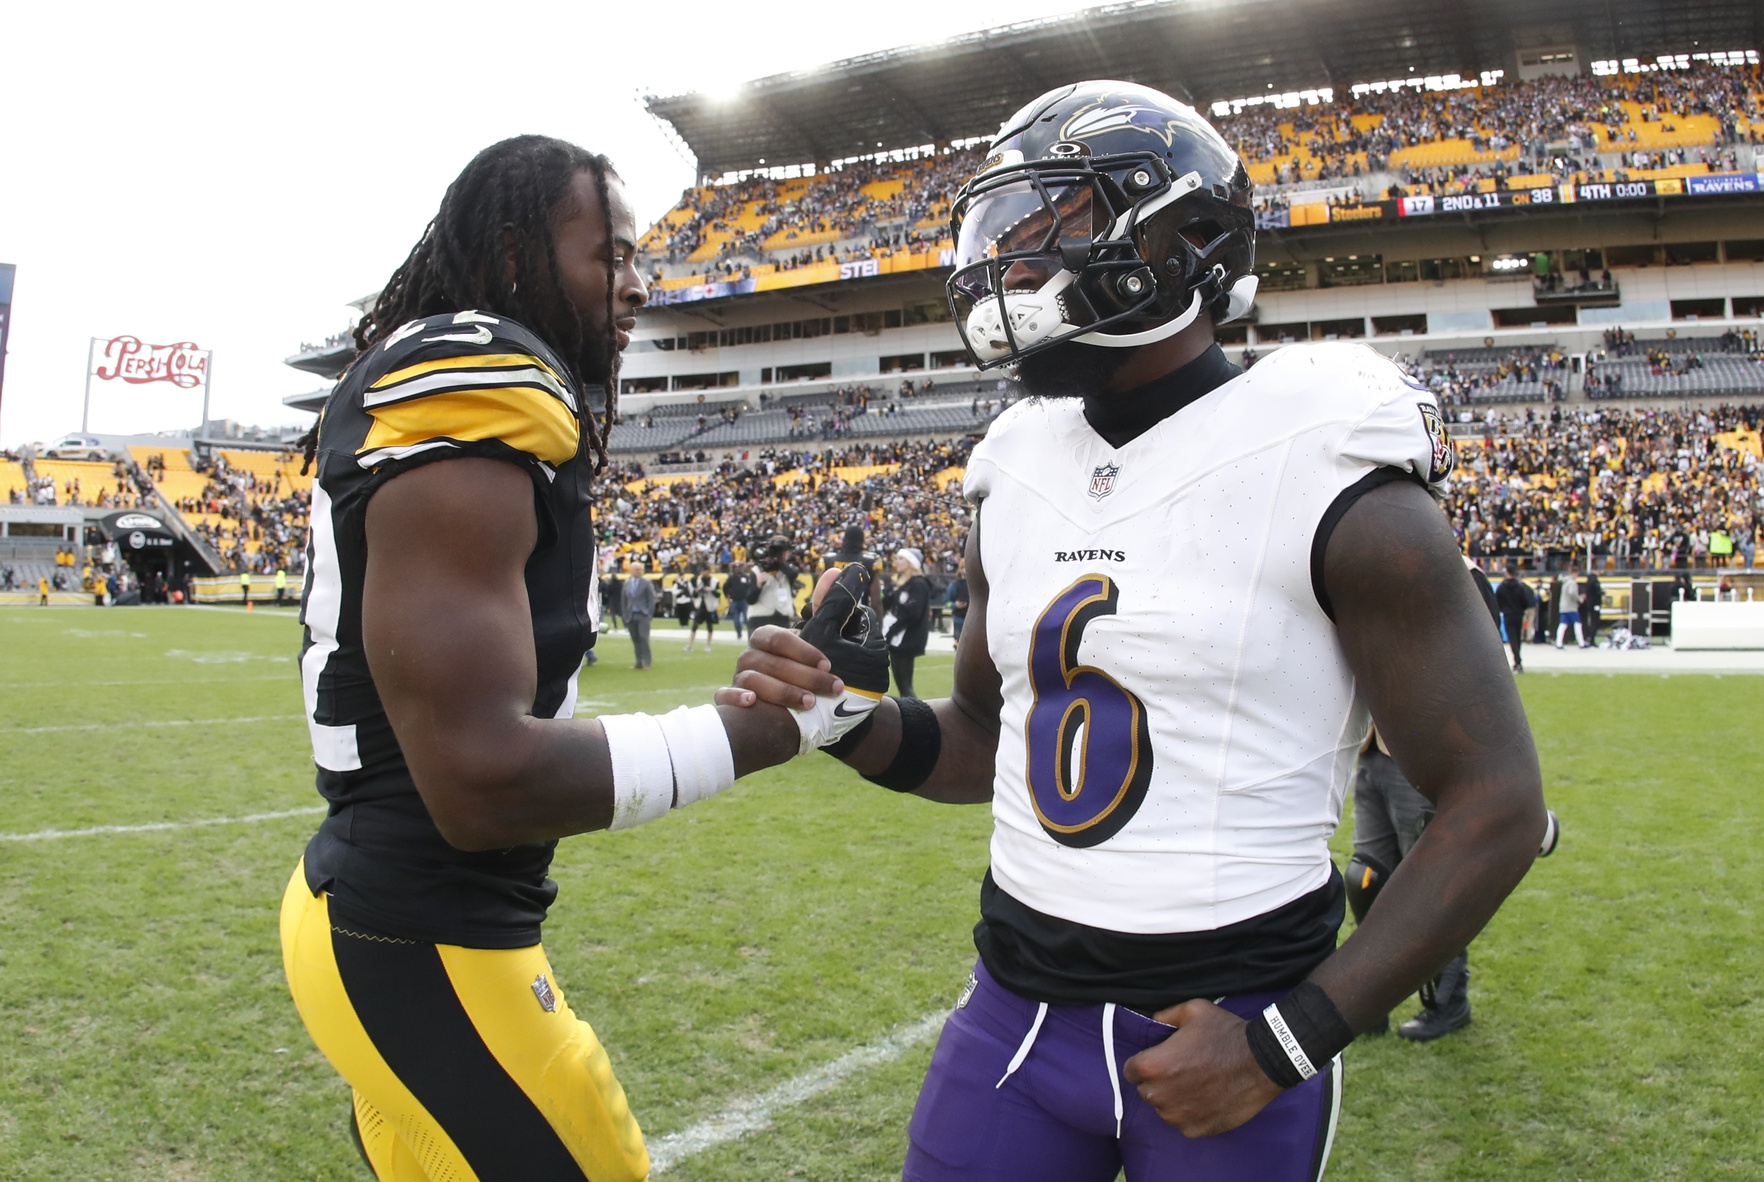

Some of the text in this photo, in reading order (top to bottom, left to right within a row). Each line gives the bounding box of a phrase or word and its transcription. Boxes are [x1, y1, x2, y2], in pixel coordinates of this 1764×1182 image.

[1580, 184, 1611, 200] 4TH
[1615, 182, 1647, 197] 0:00
[1692, 181, 1754, 193] RAVENS
[1411, 200, 1427, 213] 17
[1443, 195, 1473, 211] 2ND
[1332, 205, 1382, 220] Steelers
[1091, 477, 1112, 493] NFL
[1054, 548, 1127, 562] RAVENS
[1025, 572, 1153, 848] 6
[1270, 1016, 1312, 1075] HUMBLE OVER
